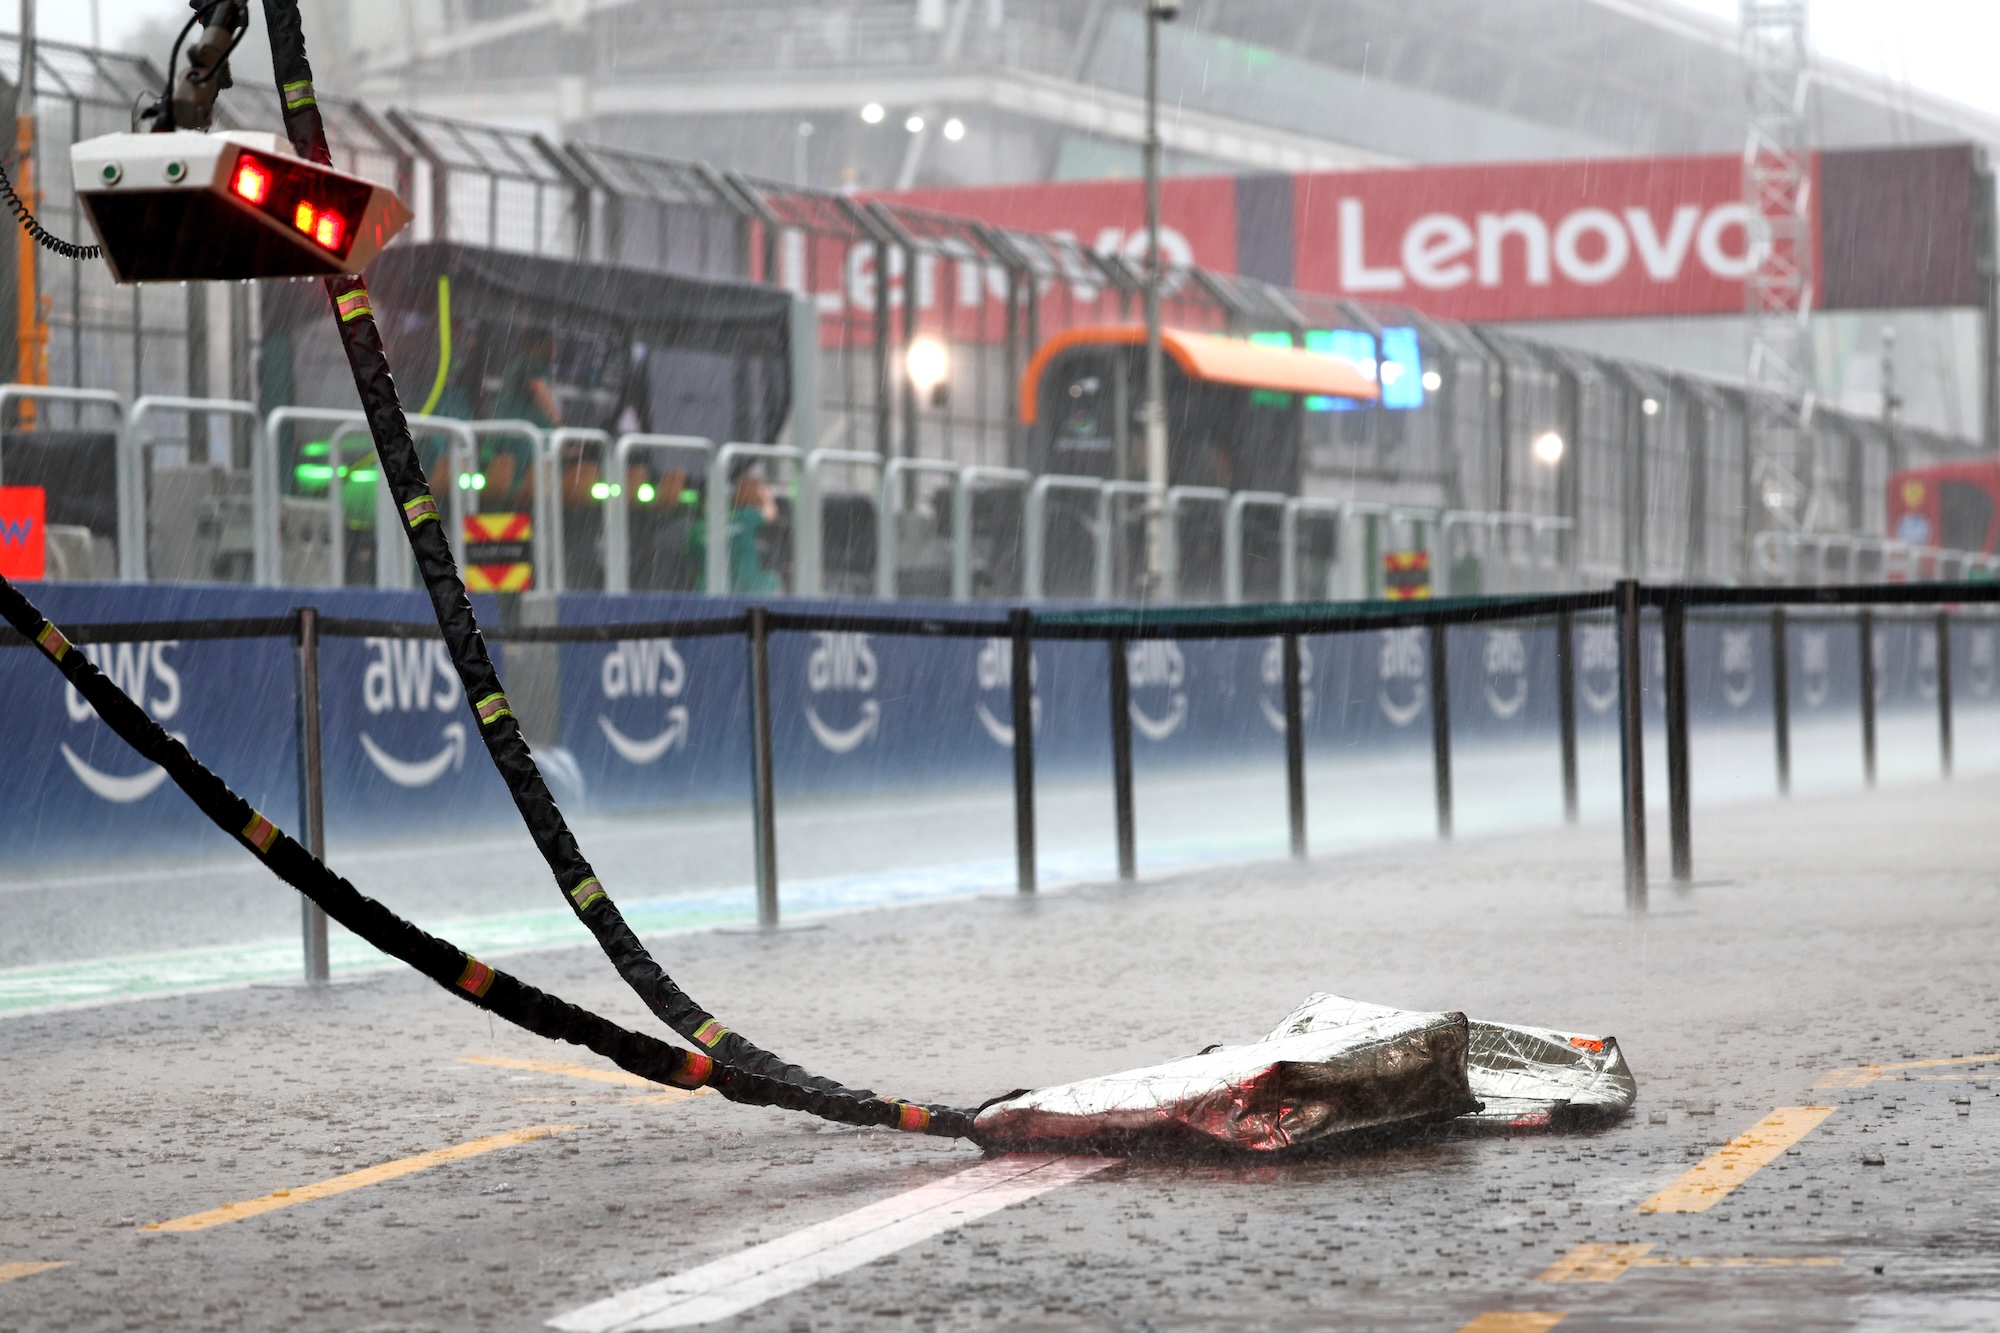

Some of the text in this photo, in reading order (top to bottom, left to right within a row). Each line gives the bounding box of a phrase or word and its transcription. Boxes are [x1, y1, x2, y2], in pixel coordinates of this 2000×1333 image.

[1338, 198, 1772, 291] Lenovo
[364, 637, 461, 714] aws
[602, 638, 685, 698] aws
[807, 631, 878, 691] aws
